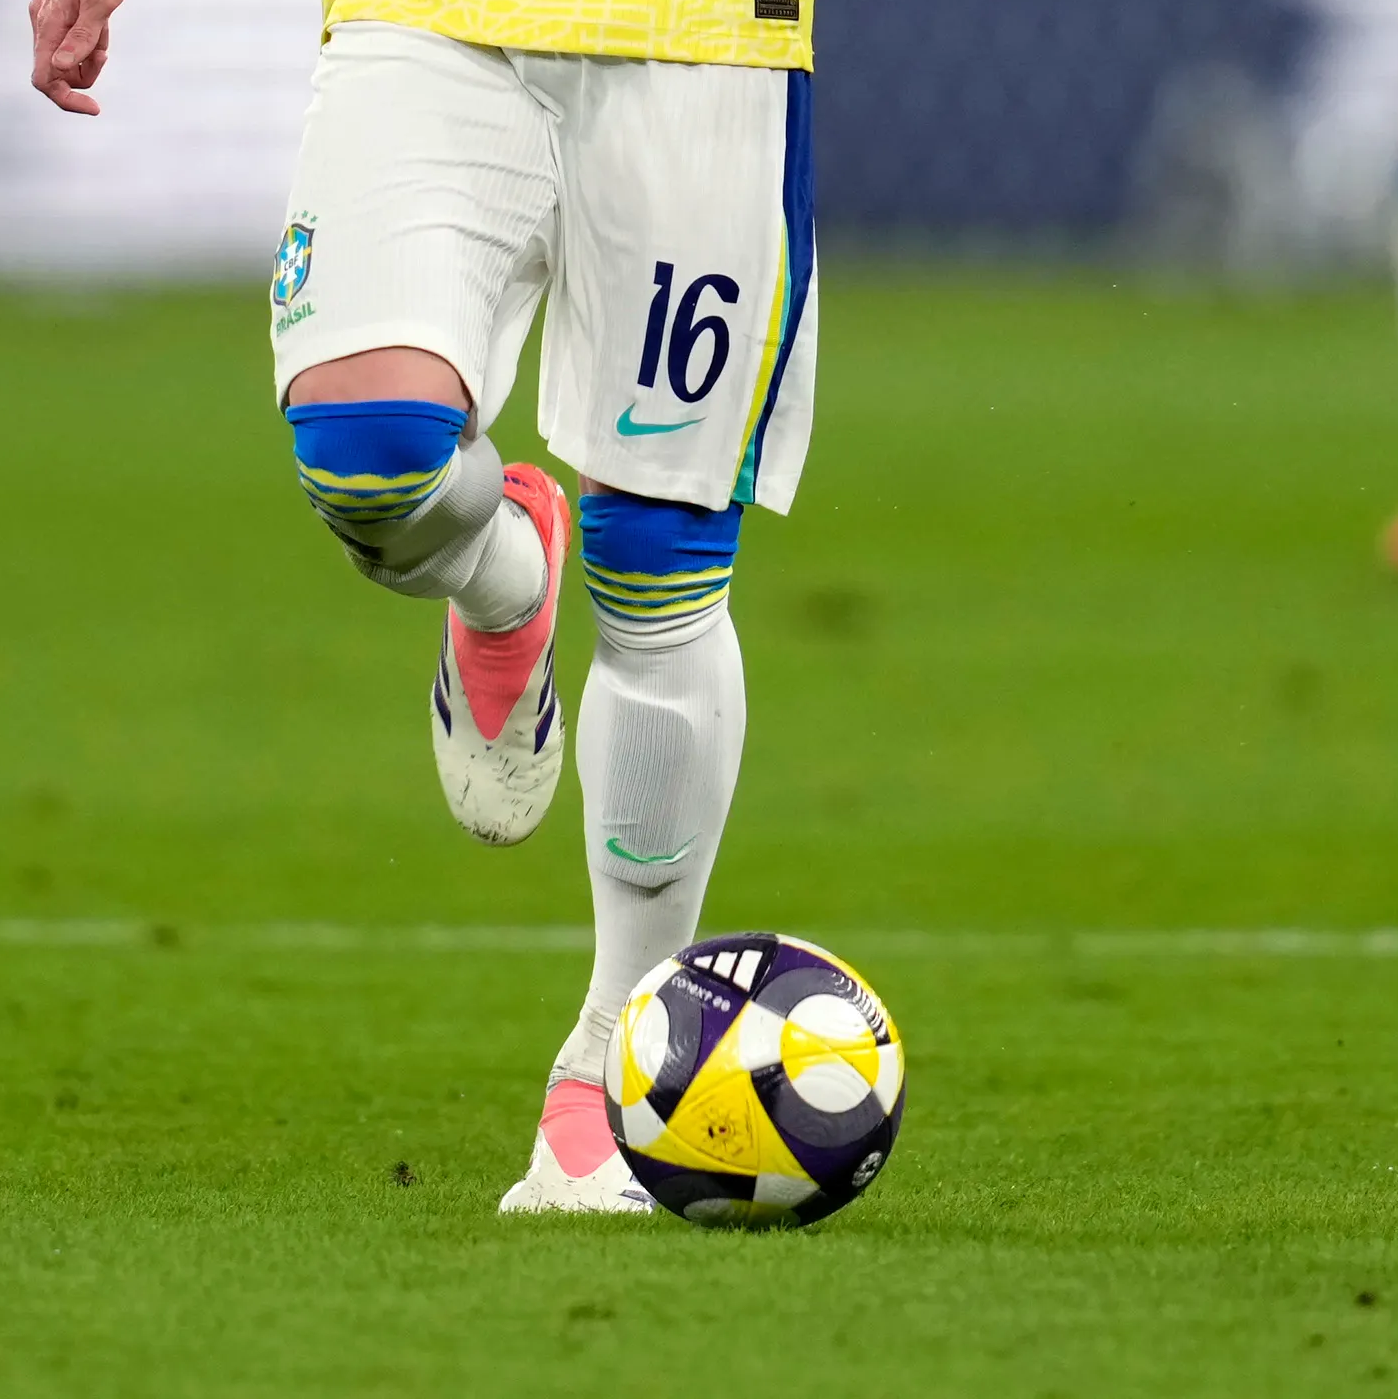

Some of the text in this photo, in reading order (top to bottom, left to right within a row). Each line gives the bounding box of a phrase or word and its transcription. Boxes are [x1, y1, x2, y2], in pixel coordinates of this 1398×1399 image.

[284, 255, 299, 271] CBF
[276, 302, 316, 337] BRASIL
[636, 260, 740, 404] 16
